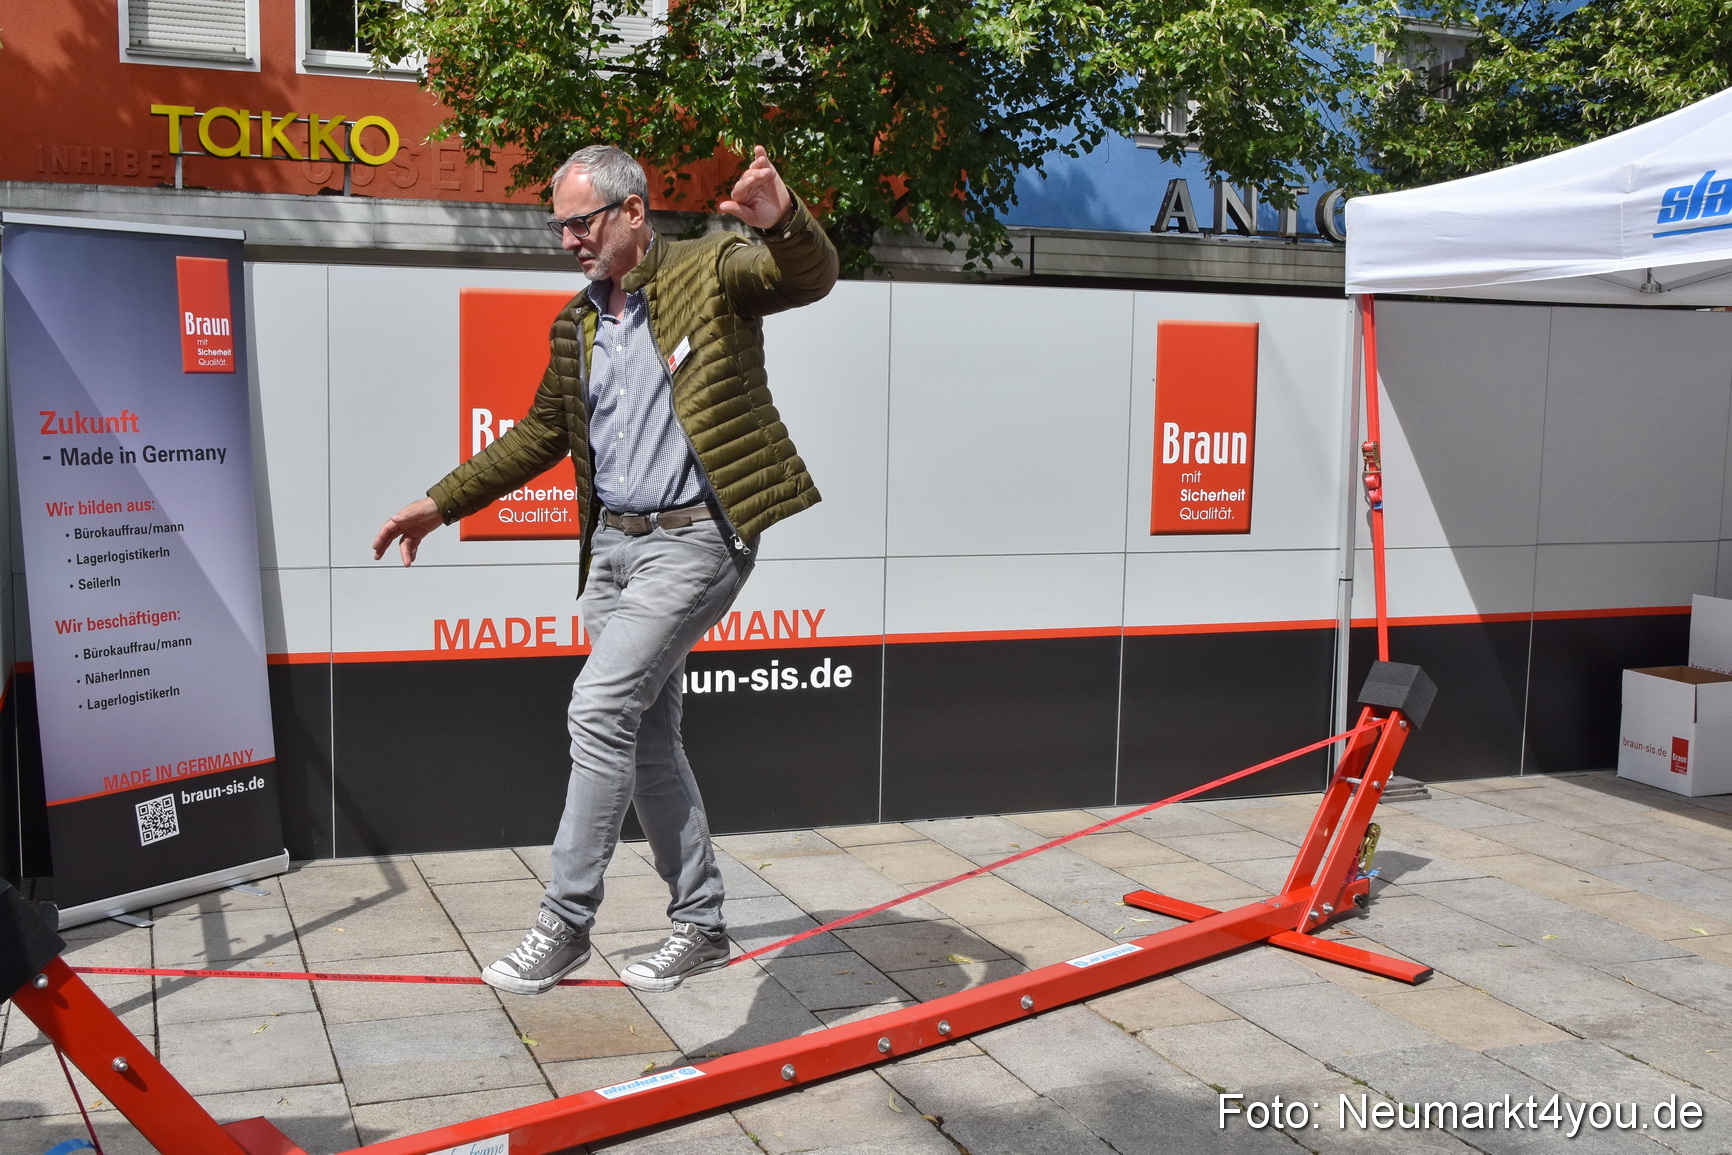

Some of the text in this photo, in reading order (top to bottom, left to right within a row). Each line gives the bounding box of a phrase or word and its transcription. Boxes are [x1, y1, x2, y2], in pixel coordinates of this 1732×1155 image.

[35, 144, 188, 180] INHABE
[184, 311, 230, 336] Braun
[197, 348, 232, 356] Sicherheit
[198, 358, 228, 366] Qualität.
[39, 409, 140, 435] Zukunft
[1162, 422, 1248, 464] Braun
[60, 447, 114, 466] Made
[119, 446, 137, 464] in
[142, 444, 227, 464] Germany
[1181, 470, 1202, 483] mit
[1180, 489, 1246, 501] Sicherheit
[45, 499, 156, 517] Wir bilden aus:
[498, 507, 572, 523] Qualität.
[1179, 507, 1235, 520] Qualität.
[74, 523, 185, 540] Bürokauffrau/mann
[76, 547, 170, 566] LagerlogistikerIn
[78, 576, 121, 590] SeilerIn
[55, 609, 181, 635] Wir beschäftigen:
[434, 616, 556, 650] MADE
[83, 636, 192, 660] Bürokauffrau/mann
[85, 666, 150, 685] NäherInnen
[87, 686, 180, 710] LagerlogistikerIn
[1622, 736, 1667, 757] braun-sis.de
[103, 749, 254, 791] MADE IN GERMANY
[181, 776, 265, 805] braun-sis.de
